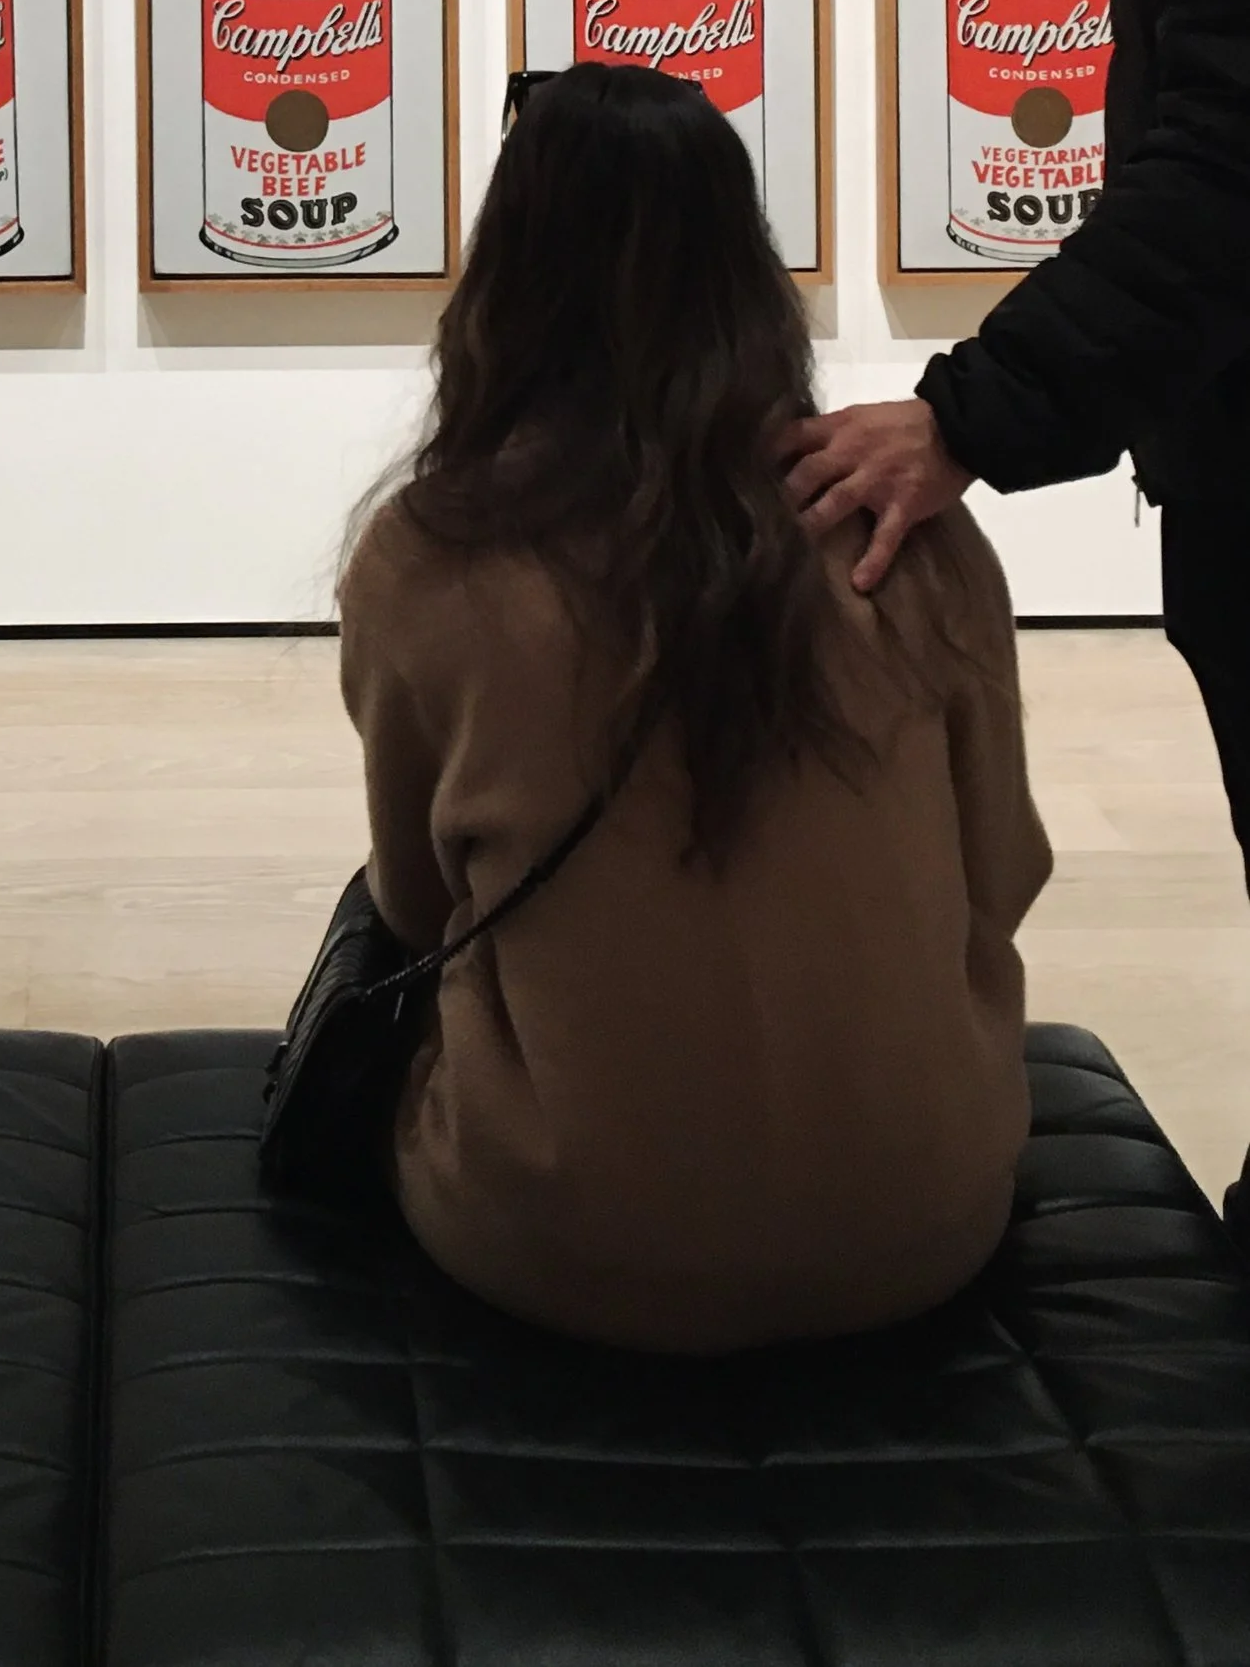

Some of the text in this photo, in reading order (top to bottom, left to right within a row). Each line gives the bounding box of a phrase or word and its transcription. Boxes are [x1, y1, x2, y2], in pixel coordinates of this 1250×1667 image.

[245, 70, 349, 84] CONDENSED
[989, 65, 1096, 81] CONDENSED
[232, 144, 364, 175] VEGETABLE
[981, 141, 1104, 166] VEGETARIAN
[263, 175, 325, 197] BEEF
[241, 192, 357, 230] SOUP
